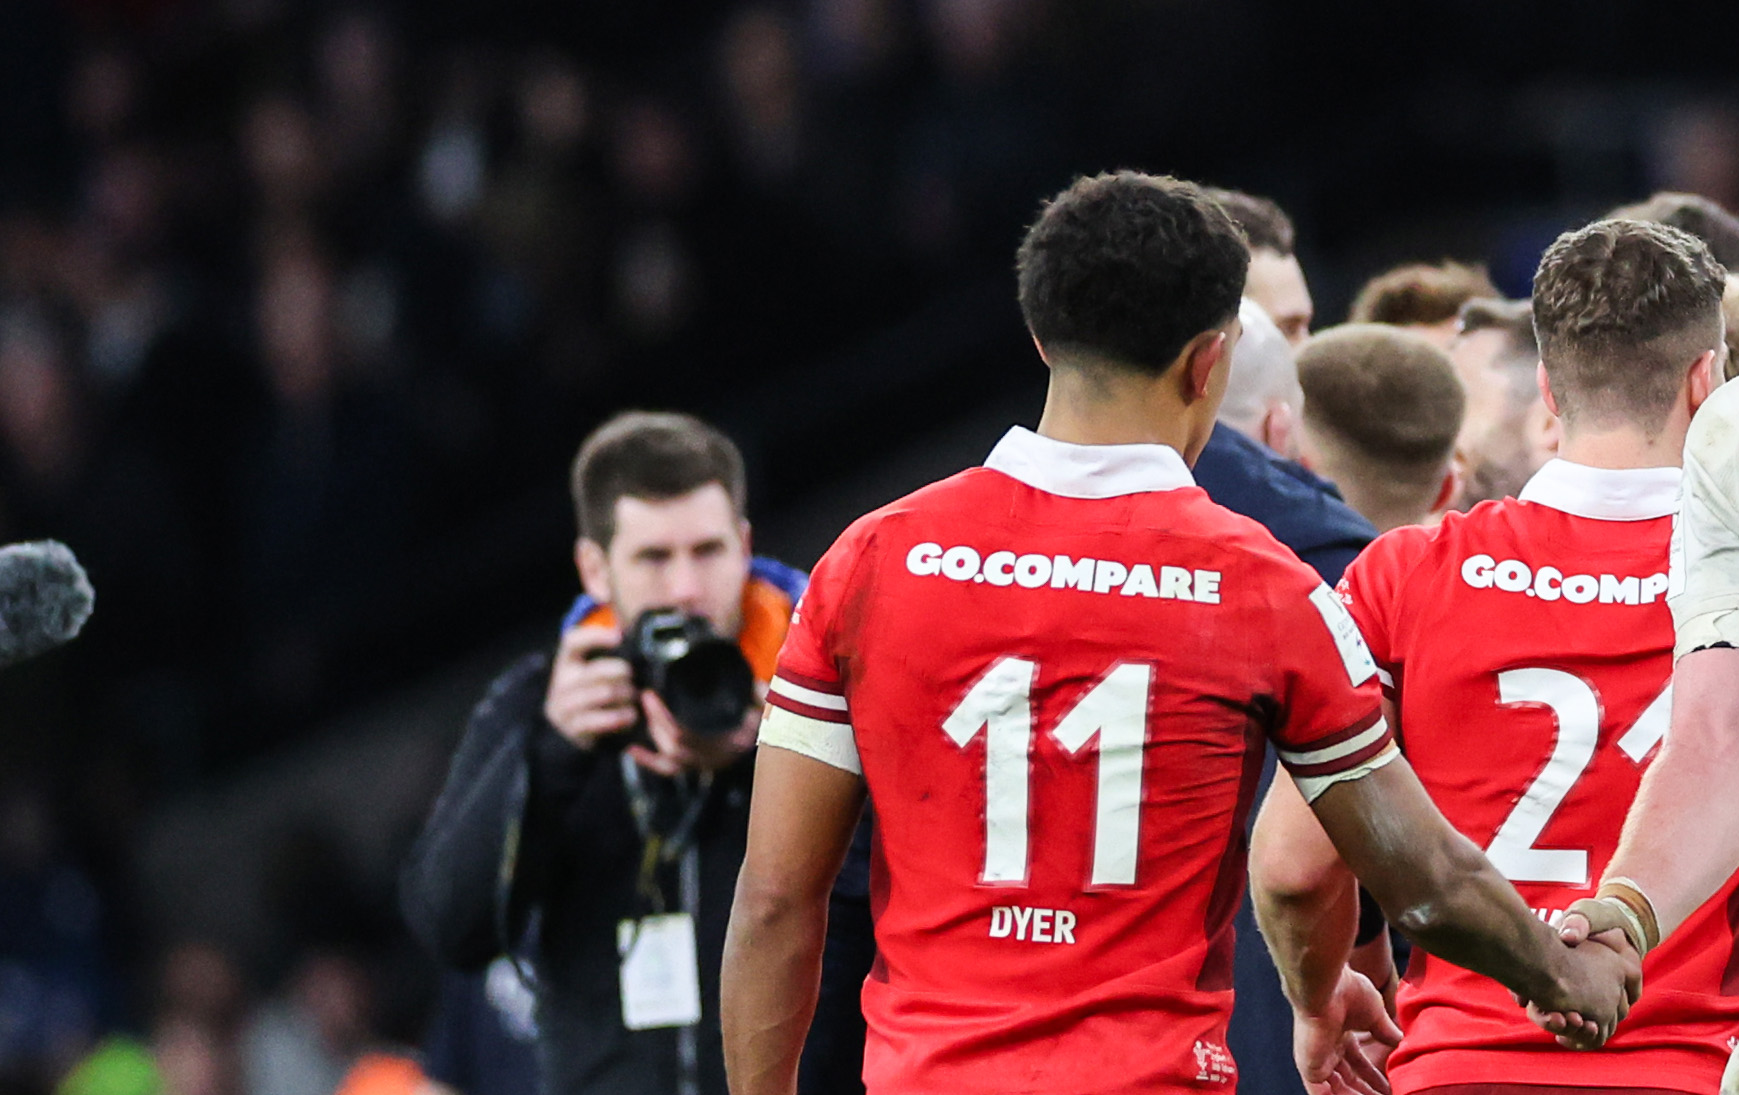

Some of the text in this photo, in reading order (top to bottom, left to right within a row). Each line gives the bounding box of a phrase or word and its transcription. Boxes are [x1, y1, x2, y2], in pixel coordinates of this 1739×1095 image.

[906, 542, 1221, 604] GO.COMPARE
[1461, 554, 1669, 605] GO.COMP
[941, 657, 1150, 885] 11
[1484, 667, 1674, 884] 2
[989, 906, 1076, 943] DYER
